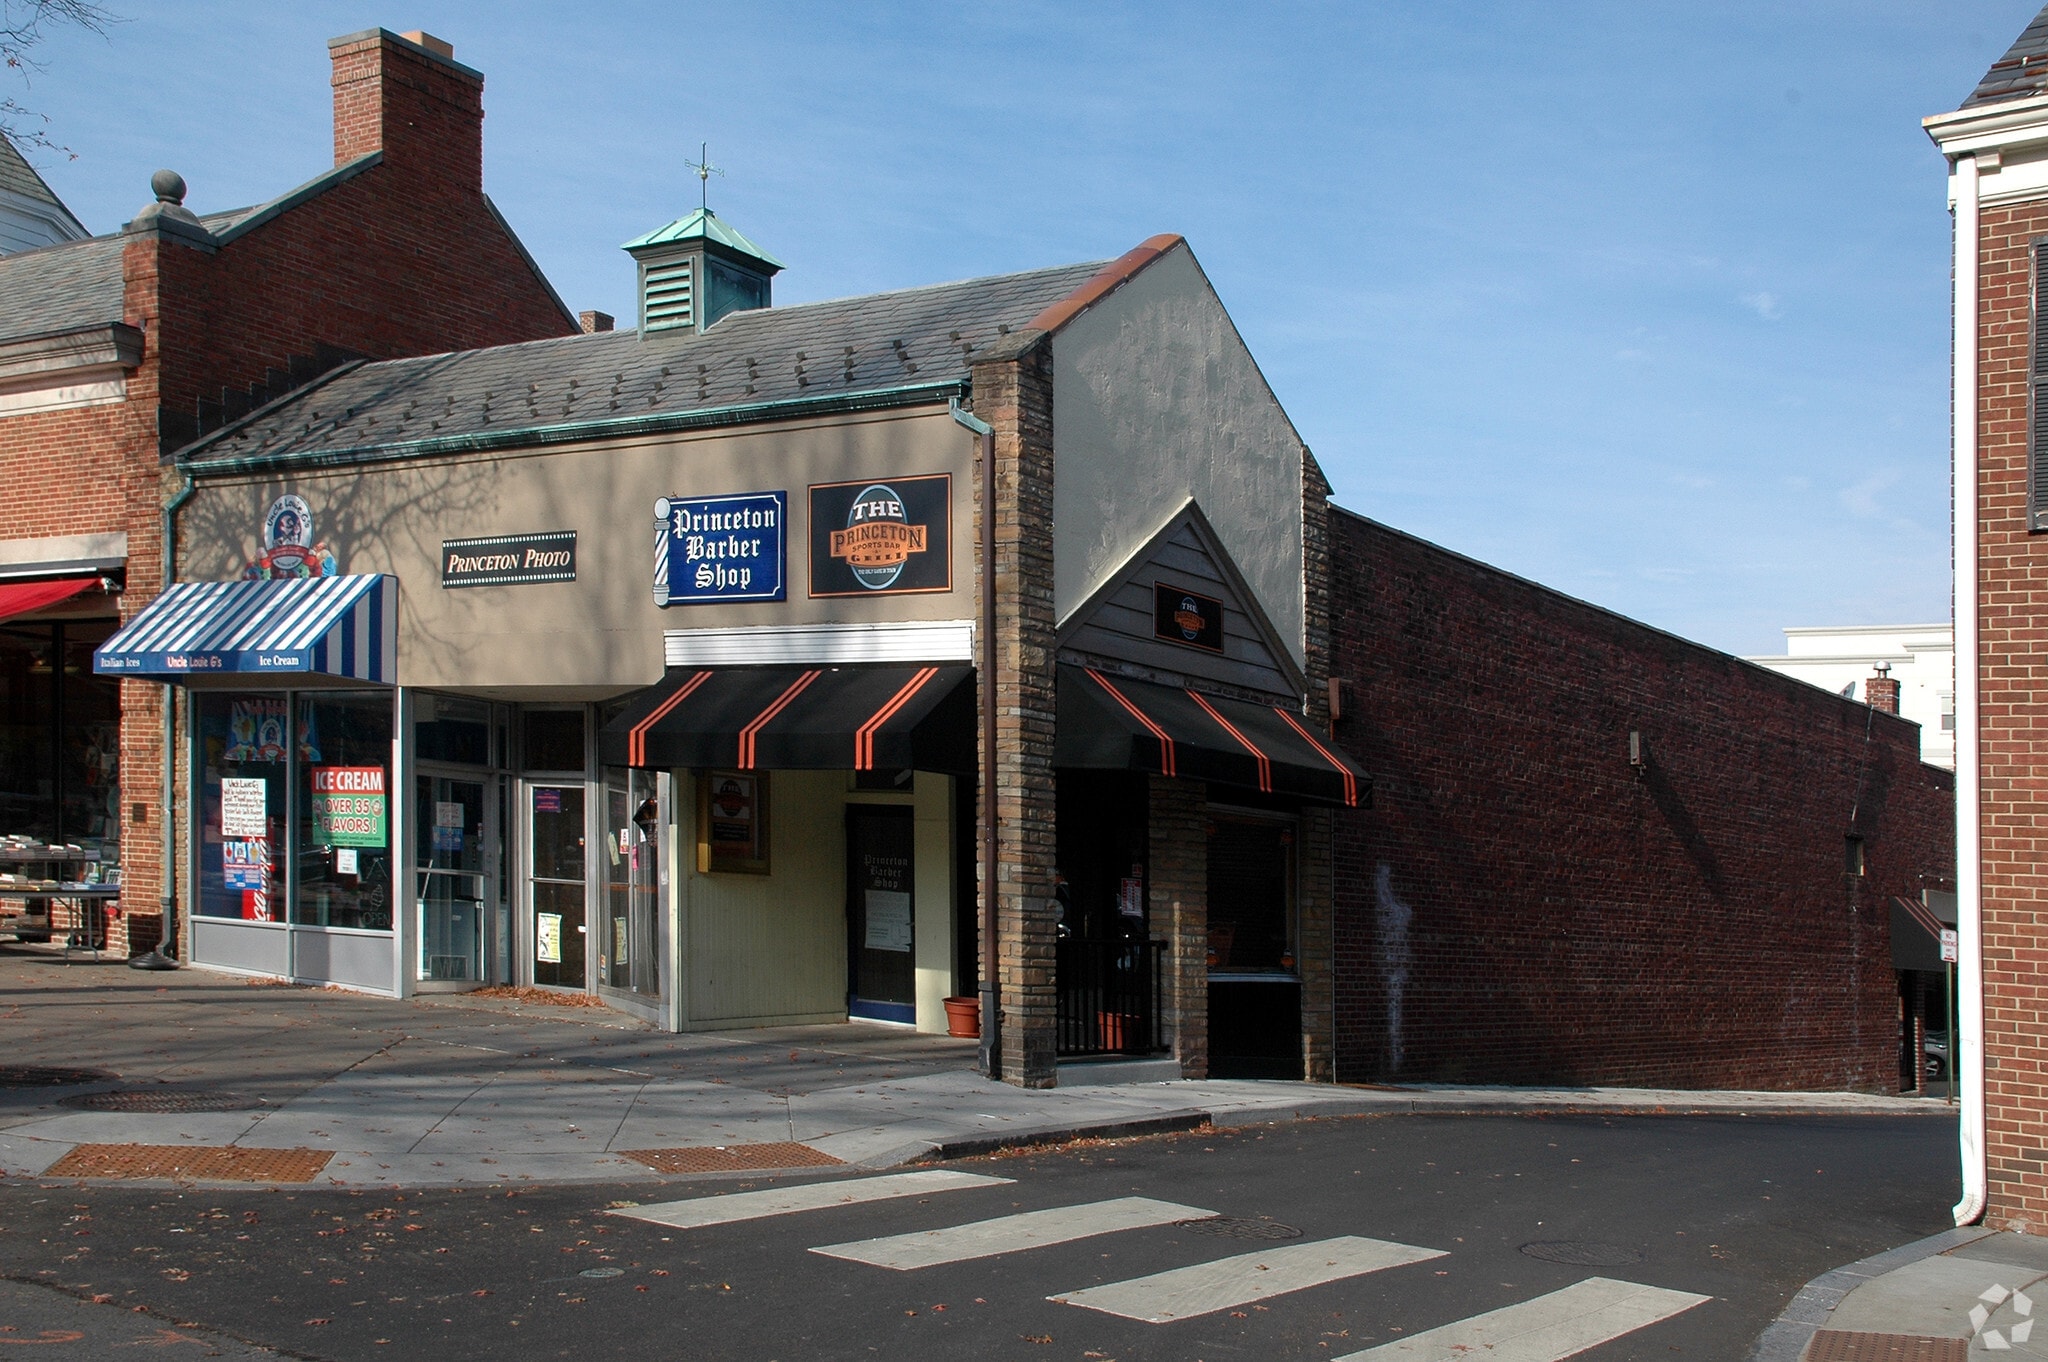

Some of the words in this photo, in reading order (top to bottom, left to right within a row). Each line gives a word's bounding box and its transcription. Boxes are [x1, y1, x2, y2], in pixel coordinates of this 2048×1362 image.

[266, 502, 283, 527] Uncle
[284, 498, 302, 514] Louie
[853, 500, 903, 520] THE
[672, 505, 775, 539] Princeton
[835, 525, 922, 553] PRINCETON
[852, 541, 882, 553] SPORTS
[884, 541, 901, 550] BAR
[685, 534, 760, 564] Barber
[851, 552, 903, 562] GRILL
[447, 554, 520, 573] PRINCETON
[523, 549, 570, 568] PHOTO
[695, 563, 751, 591] Shop
[101, 658, 124, 667] Italian
[126, 657, 140, 667] Ices
[167, 656, 188, 668] Uncle
[189, 656, 208, 667] Louie
[210, 656, 222, 668] G's
[259, 656, 272, 666] Ice
[273, 655, 299, 665] Cream
[315, 771, 334, 790] ICE
[336, 771, 383, 790] CREAM
[324, 798, 353, 814] OVER
[355, 798, 370, 815] 35
[322, 816, 370, 834] FLAVORS
[864, 854, 908, 866] Princeton
[870, 865, 902, 878] Barber
[873, 877, 898, 890] Shop
